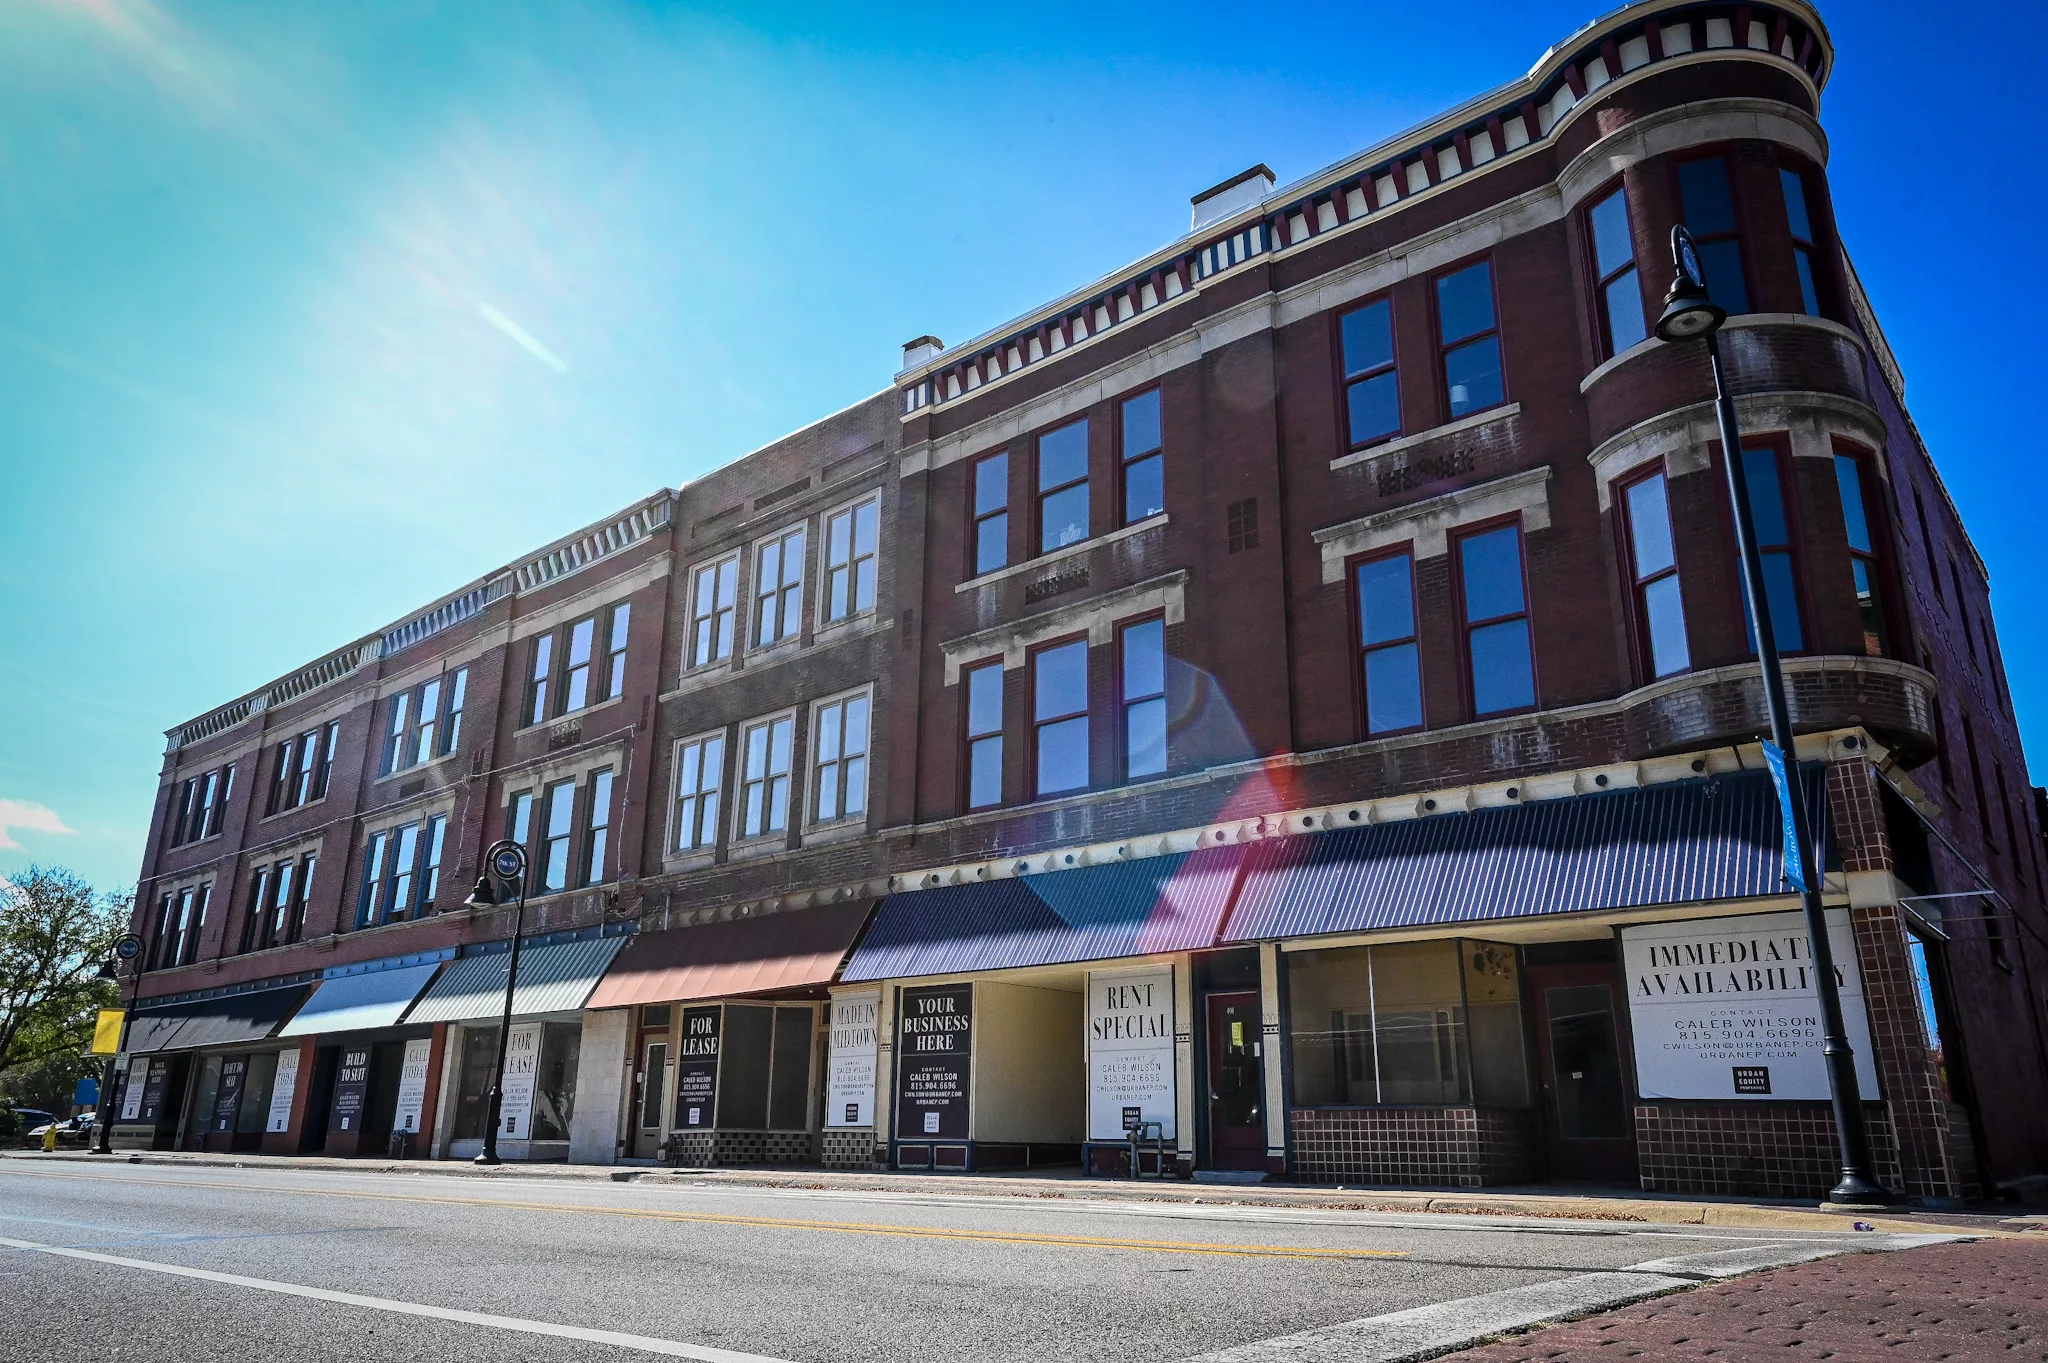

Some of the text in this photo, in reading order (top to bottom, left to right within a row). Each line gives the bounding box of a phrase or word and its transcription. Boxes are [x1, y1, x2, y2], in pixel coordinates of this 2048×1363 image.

[1636, 963, 1848, 997] AVAILABILIY
[1107, 983, 1155, 1010] RENT
[918, 997, 955, 1014] YOUR
[1710, 1008, 1774, 1017] CONTACT
[837, 1003, 877, 1025] MADE IN
[690, 1016, 713, 1035] FOR
[904, 1014, 969, 1033] BUSINESS
[1093, 1013, 1170, 1041] SPECIAL
[1675, 1016, 1817, 1030] CALEB WILSON
[511, 1032, 532, 1051] FOR
[833, 1027, 878, 1049] MIDTOWN
[1679, 1028, 1815, 1041] 815.904.6696
[682, 1037, 718, 1056] LEASE
[916, 1034, 954, 1051] HERE
[1662, 1040, 1824, 1051] CWILSON@URBANEP.CO
[346, 1052, 367, 1067] BUILD
[409, 1048, 428, 1063] CALL
[1700, 1051, 1798, 1060] URBANEP.COM
[503, 1054, 534, 1075] LEASE
[1102, 1062, 1161, 1073] CALEB WILSON
[341, 1067, 367, 1082] TO SUIT
[910, 1072, 958, 1081] CALEB WILSON
[1103, 1073, 1160, 1083] 815.904.6696
[1737, 1069, 1765, 1077] URBAN
[910, 1081, 957, 1090] 815.904.6696
[1738, 1077, 1766, 1085] EQUITY
